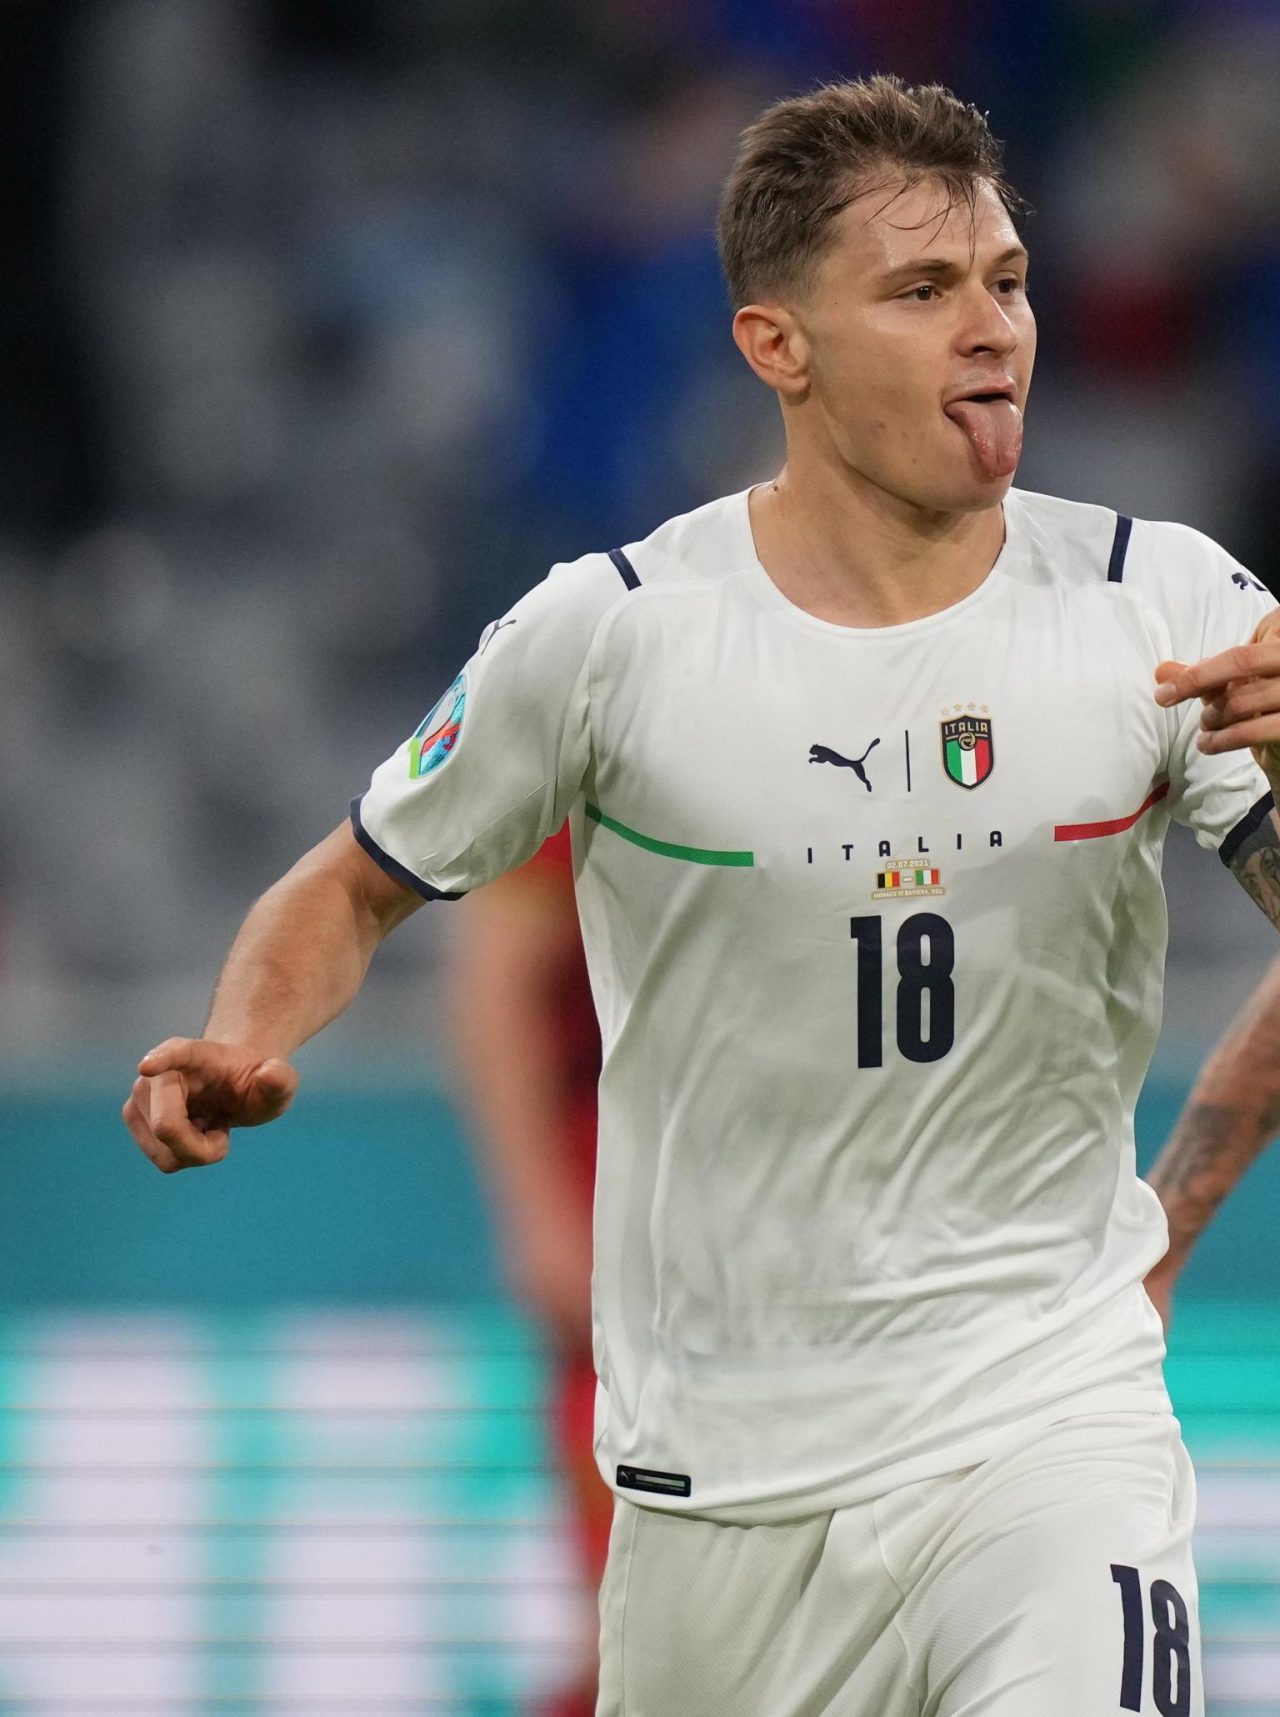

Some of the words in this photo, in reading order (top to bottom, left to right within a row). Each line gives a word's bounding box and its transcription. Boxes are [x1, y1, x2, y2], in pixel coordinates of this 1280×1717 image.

[944, 721, 989, 735] ITALIA
[807, 830, 1003, 864] ITALIA
[850, 912, 955, 1069] 18
[1110, 1563, 1191, 1717] 18
